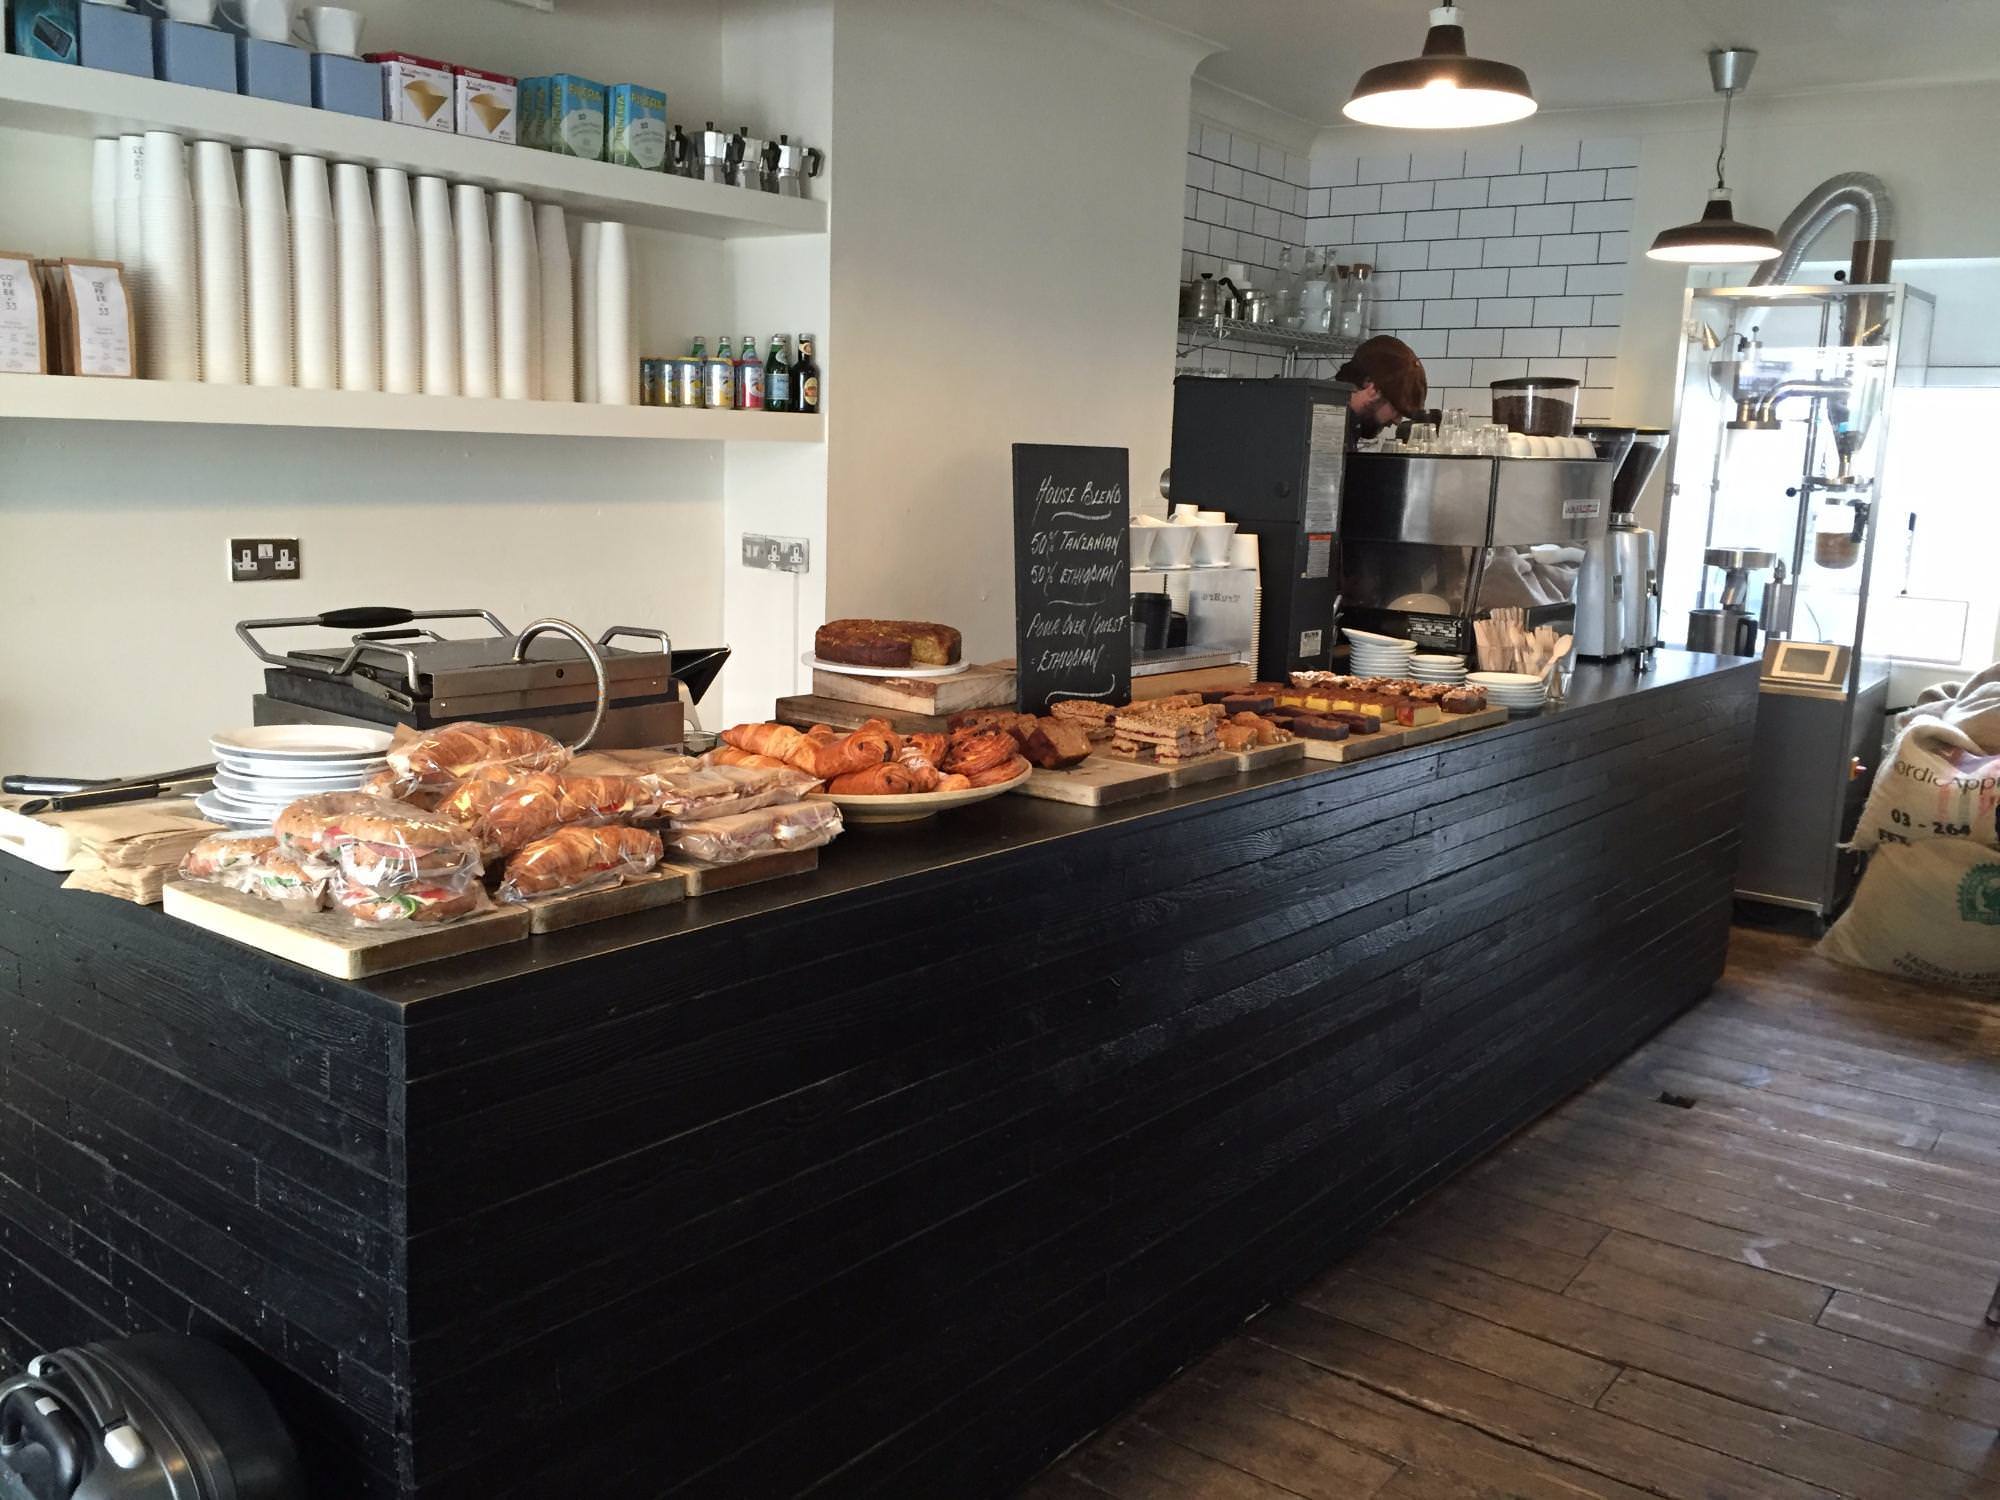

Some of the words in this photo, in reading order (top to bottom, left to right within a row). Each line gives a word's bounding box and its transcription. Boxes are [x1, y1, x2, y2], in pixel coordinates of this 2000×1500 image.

[1033, 475, 1077, 519] HOUSE
[1080, 481, 1121, 506] BLEND
[1060, 528, 1125, 556] TANZANIAN
[1891, 808, 1911, 828] 03
